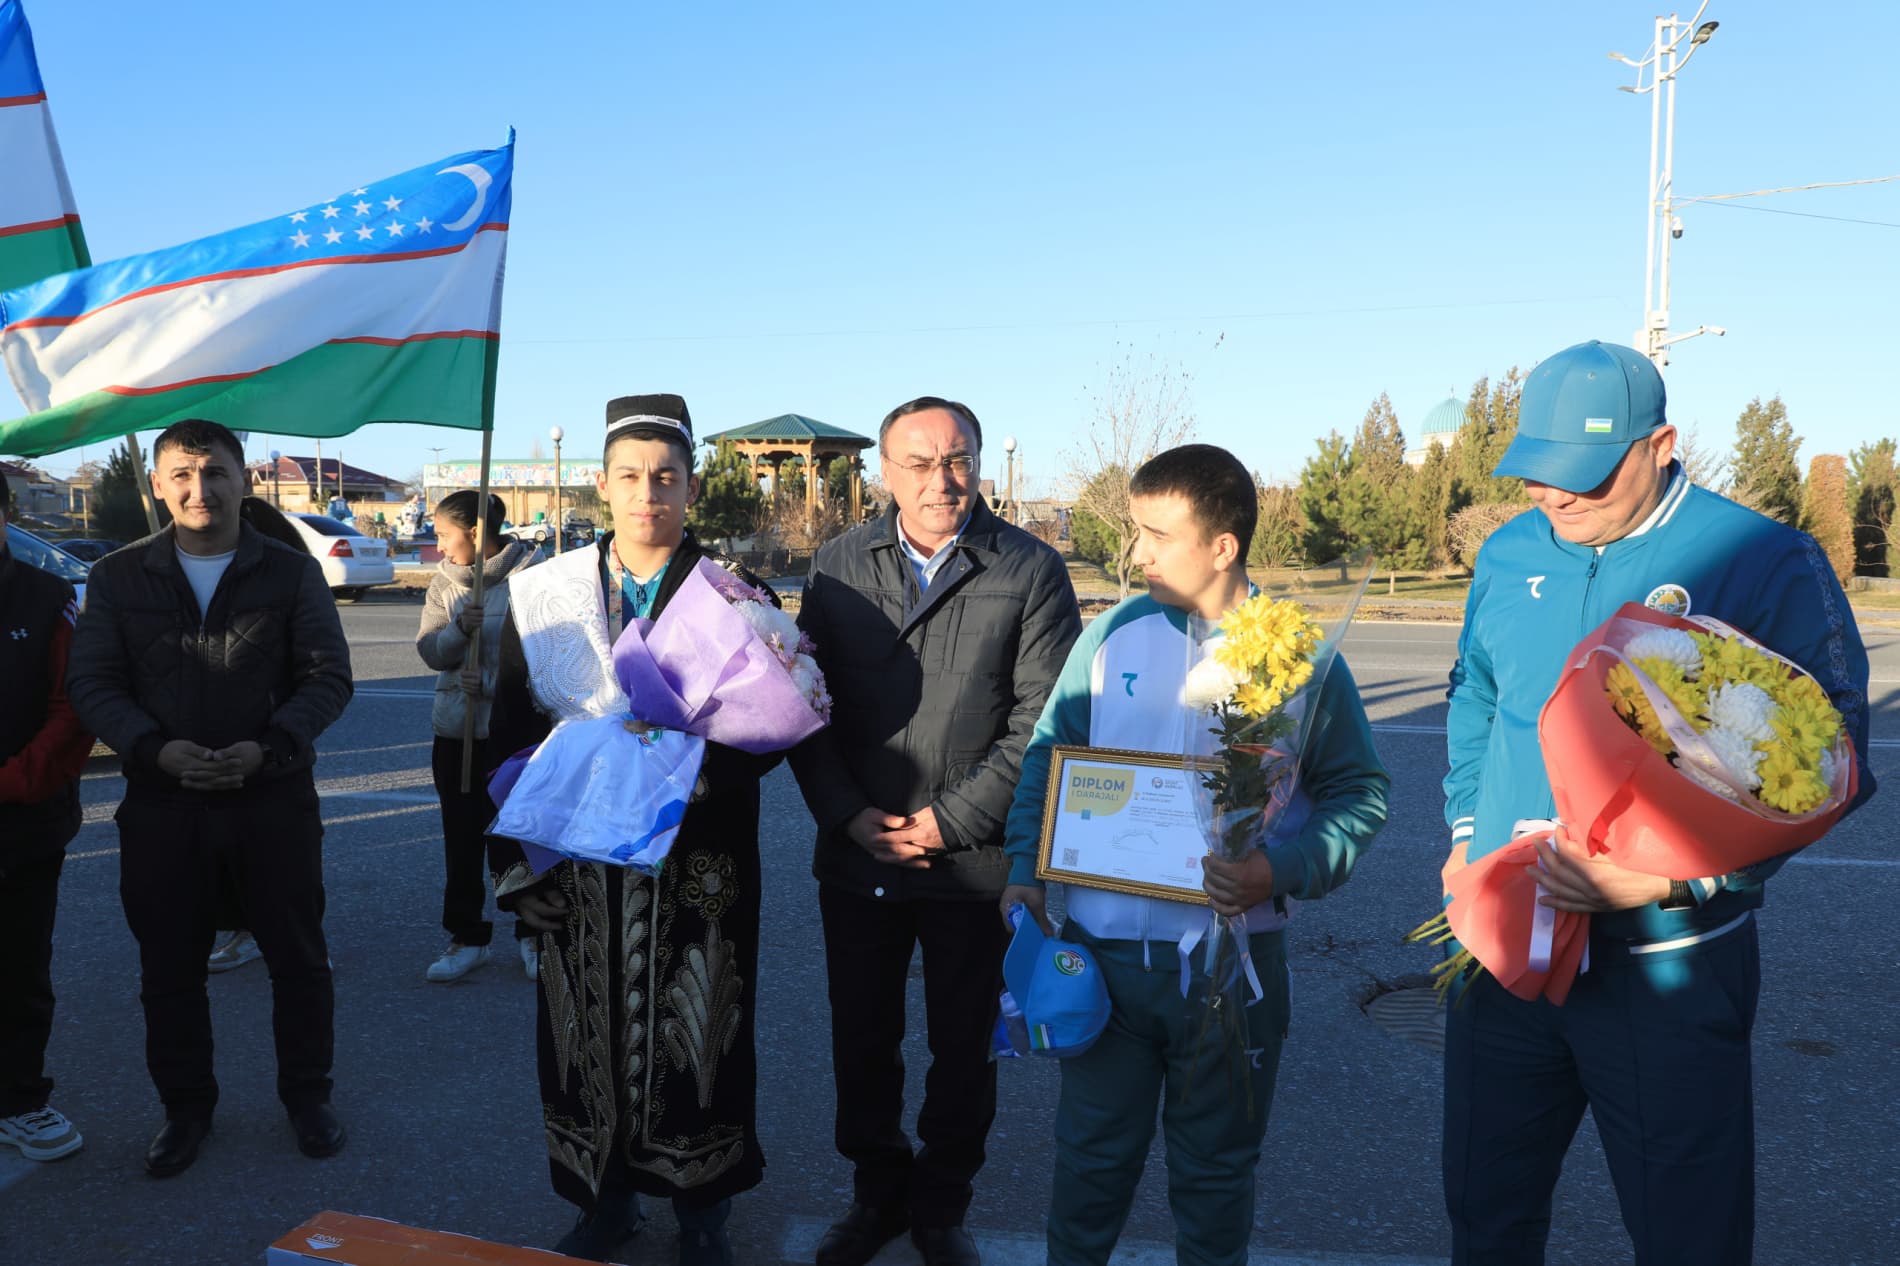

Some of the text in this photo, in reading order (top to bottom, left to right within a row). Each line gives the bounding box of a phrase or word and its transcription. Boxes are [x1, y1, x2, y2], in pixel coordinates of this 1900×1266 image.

[1071, 776, 1126, 792] DIPLOM
[1076, 790, 1119, 801] DARAJALI
[311, 1233, 345, 1247] FRONT
